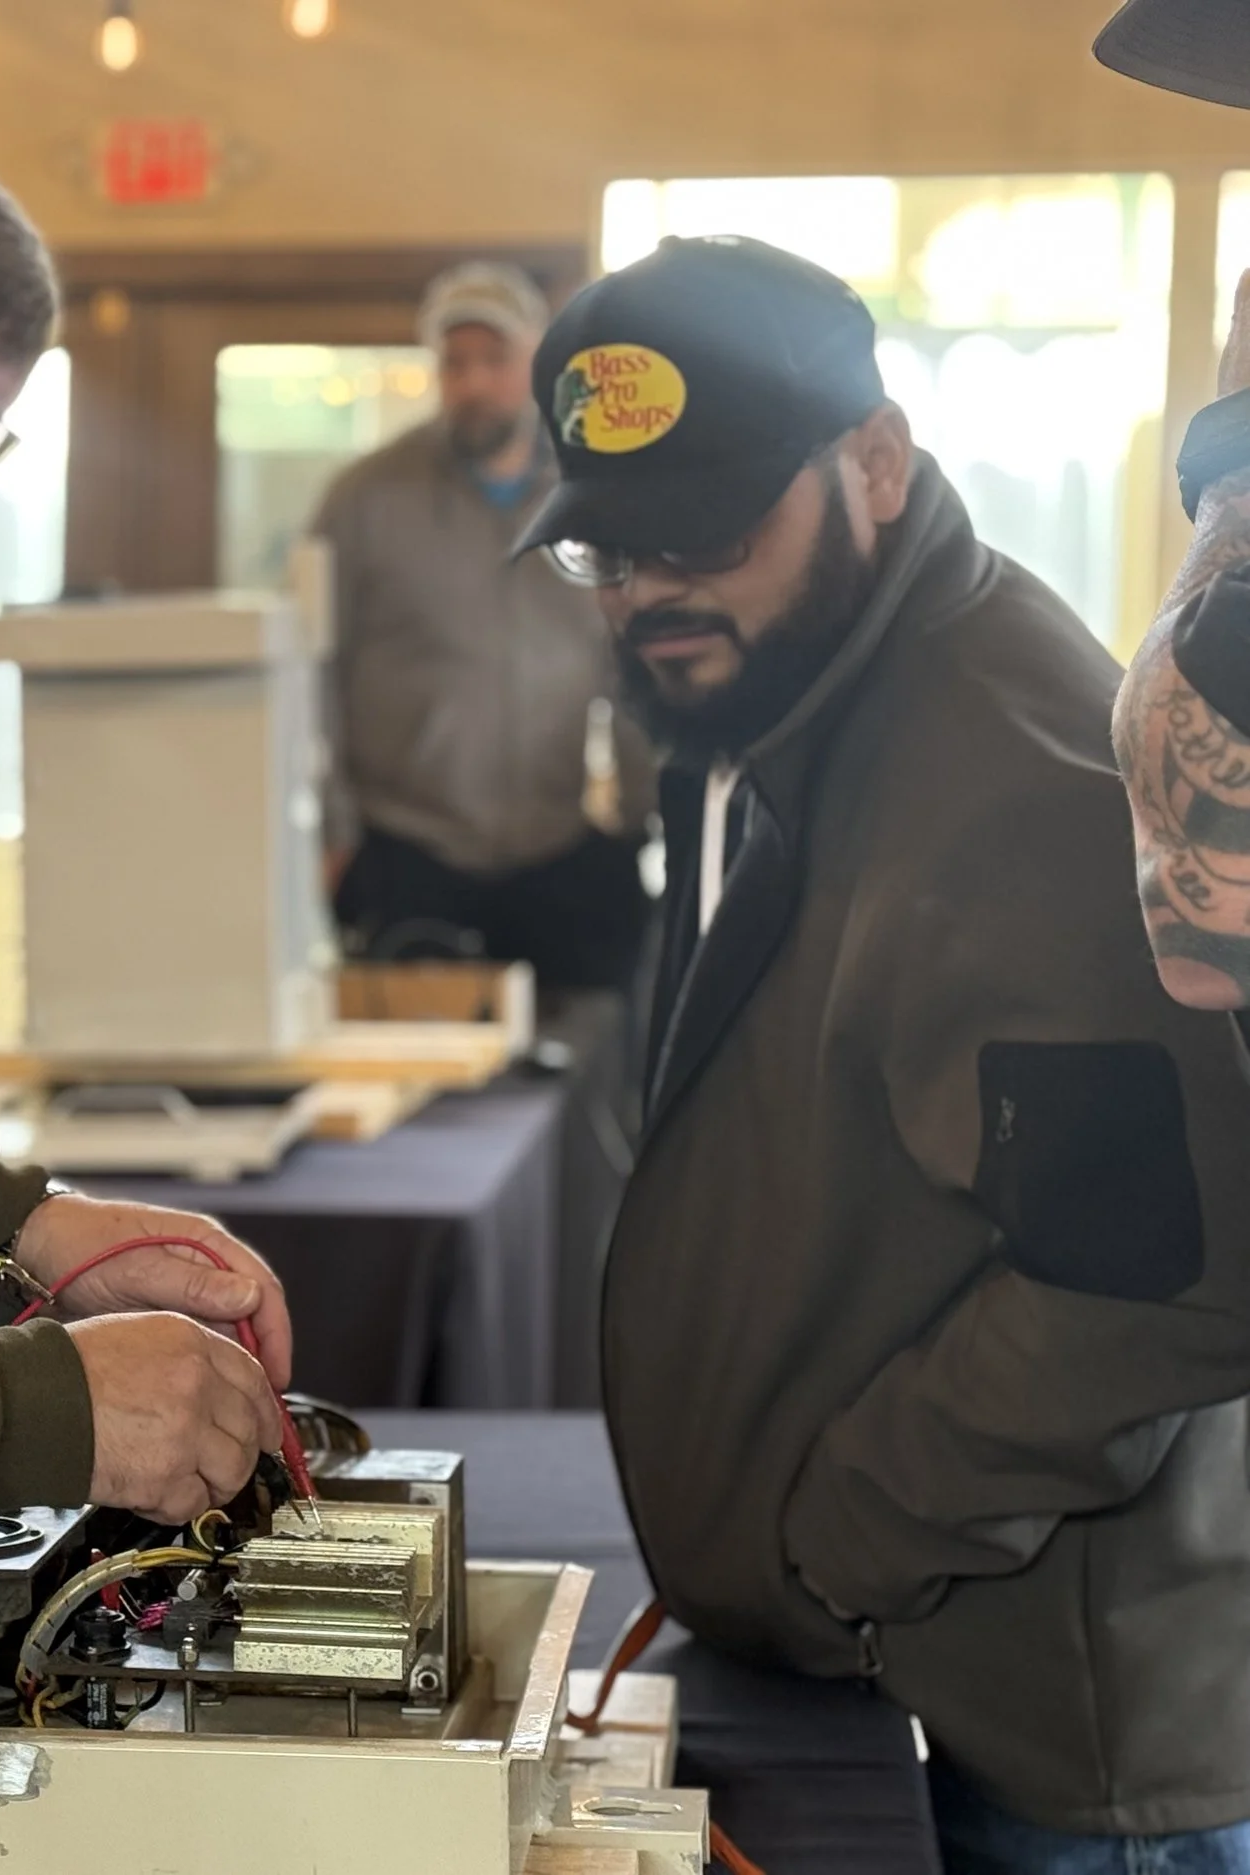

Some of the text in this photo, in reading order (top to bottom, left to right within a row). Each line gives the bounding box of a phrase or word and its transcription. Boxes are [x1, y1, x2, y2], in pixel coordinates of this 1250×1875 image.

[591, 351, 651, 381] Bass
[599, 380, 638, 407] Pro
[600, 404, 675, 435] Shops
